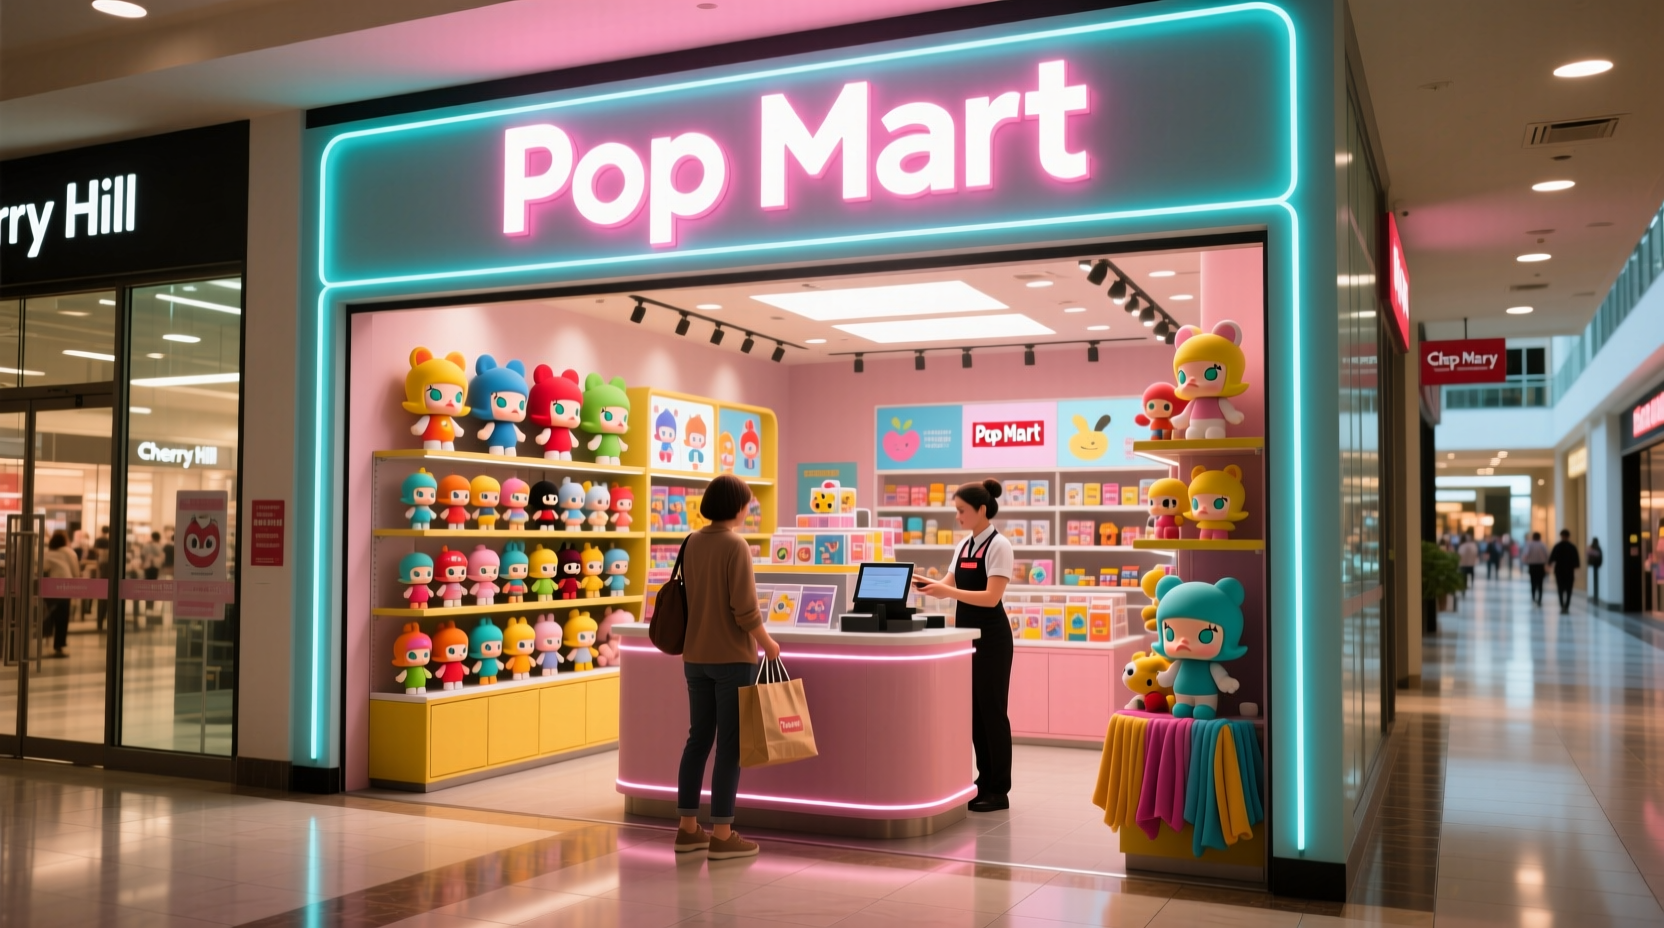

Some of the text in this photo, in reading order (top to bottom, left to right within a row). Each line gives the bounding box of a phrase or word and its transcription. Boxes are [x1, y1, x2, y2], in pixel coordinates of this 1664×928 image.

[503, 59, 1090, 246] Pop Mart
[65, 173, 136, 238] Hill
[1462, 351, 1498, 370] Mary
[975, 424, 1003, 447] Pop
[1003, 423, 1041, 442] Mart
[137, 441, 218, 469] Cherry Hill
